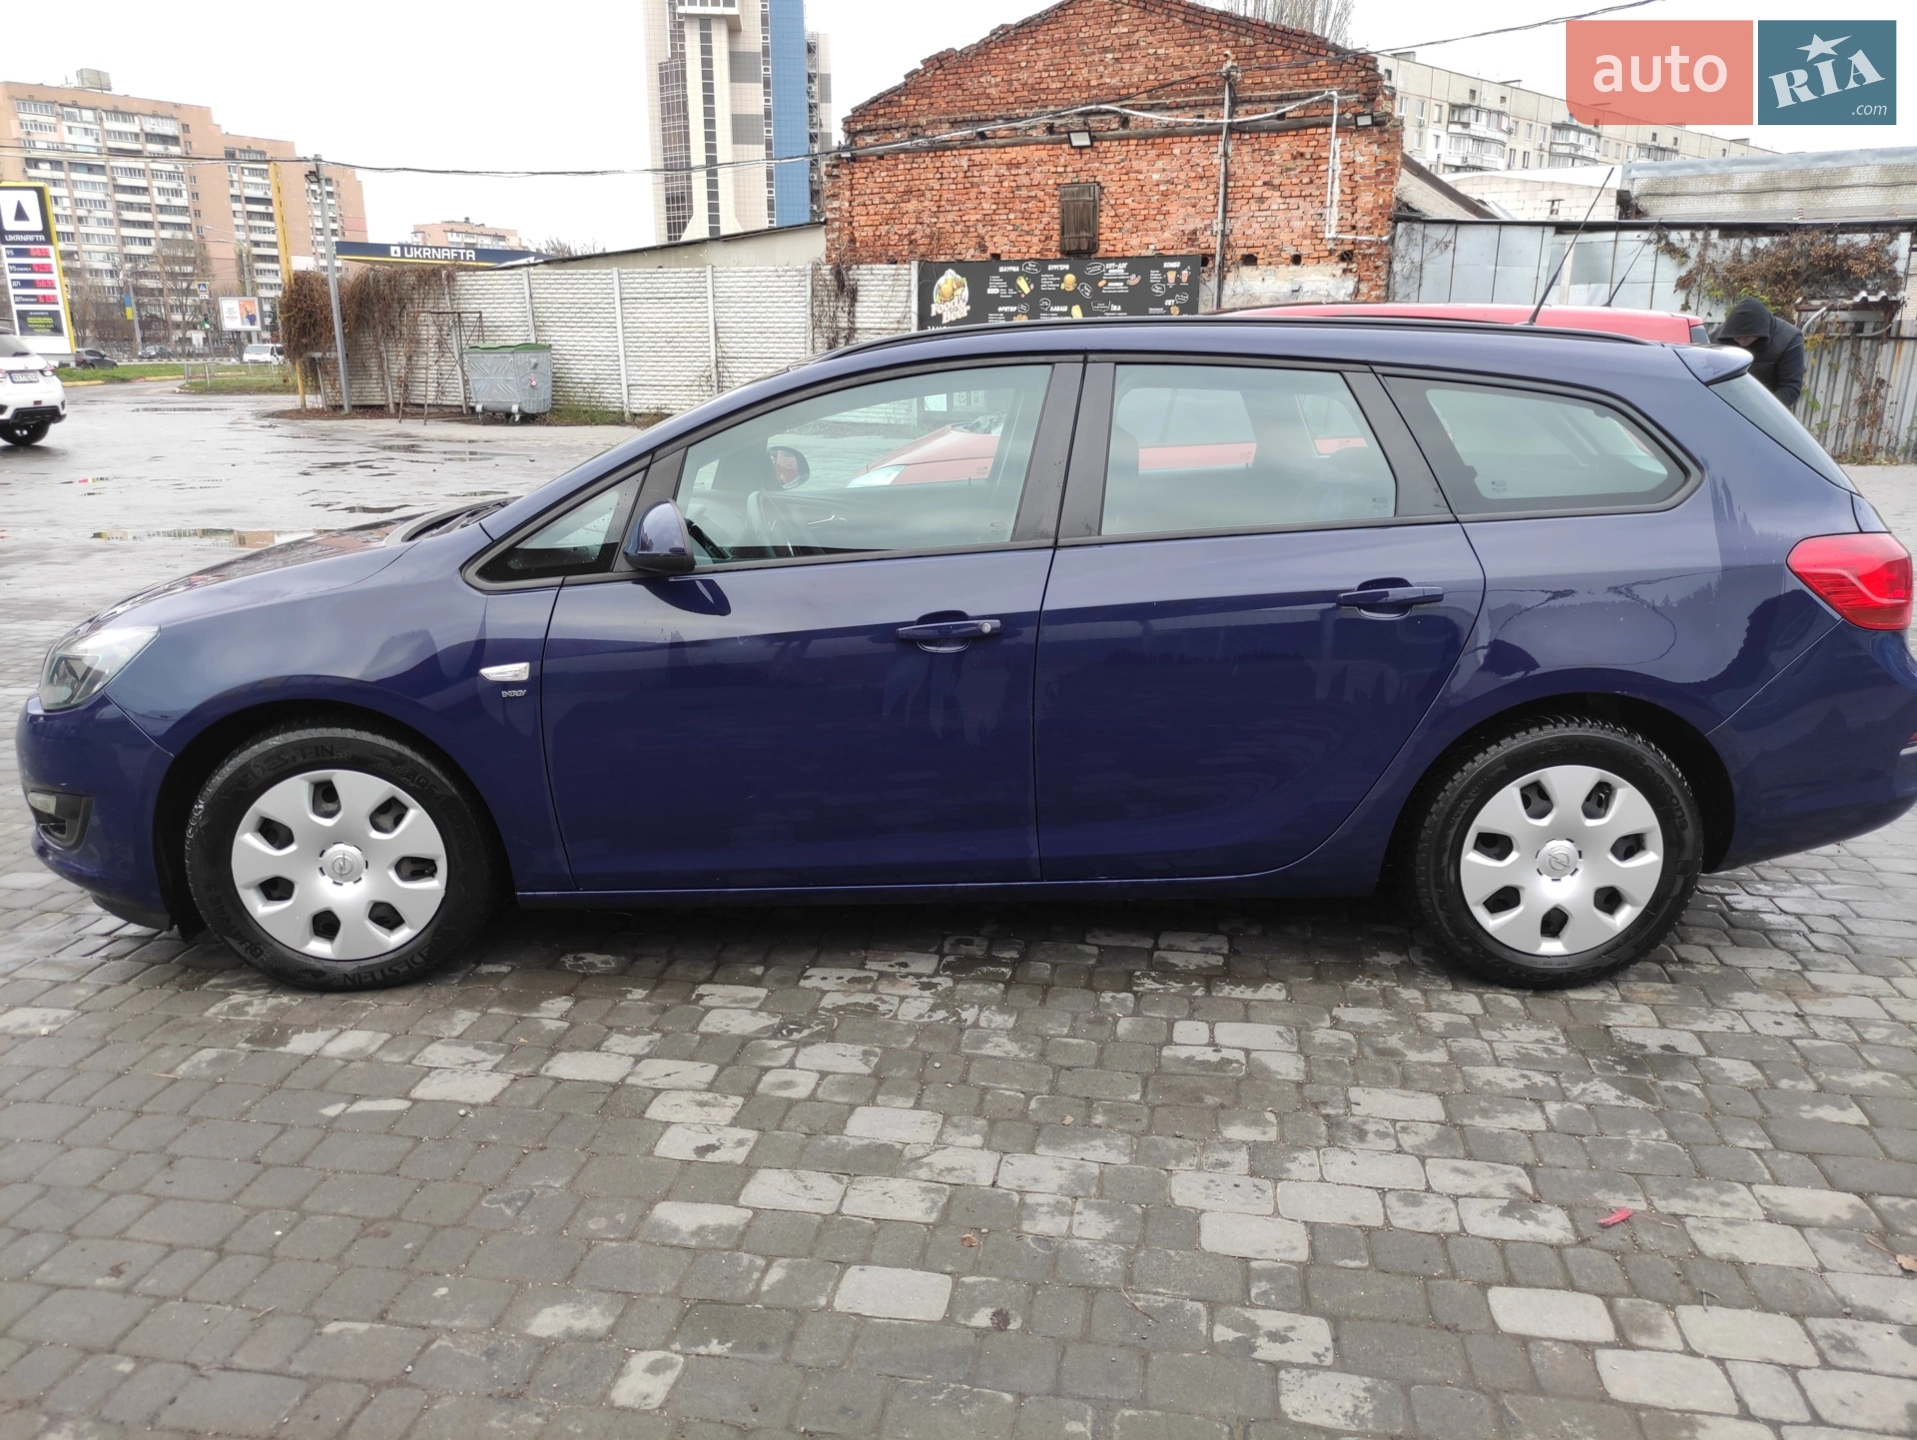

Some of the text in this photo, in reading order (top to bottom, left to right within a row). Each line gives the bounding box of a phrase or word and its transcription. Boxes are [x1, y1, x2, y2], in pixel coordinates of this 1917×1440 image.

[4, 234, 46, 242] UKRNAFTA
[404, 246, 475, 261] UKRNAFTA
[931, 296, 960, 317] Food
[942, 305, 971, 324] Beer
